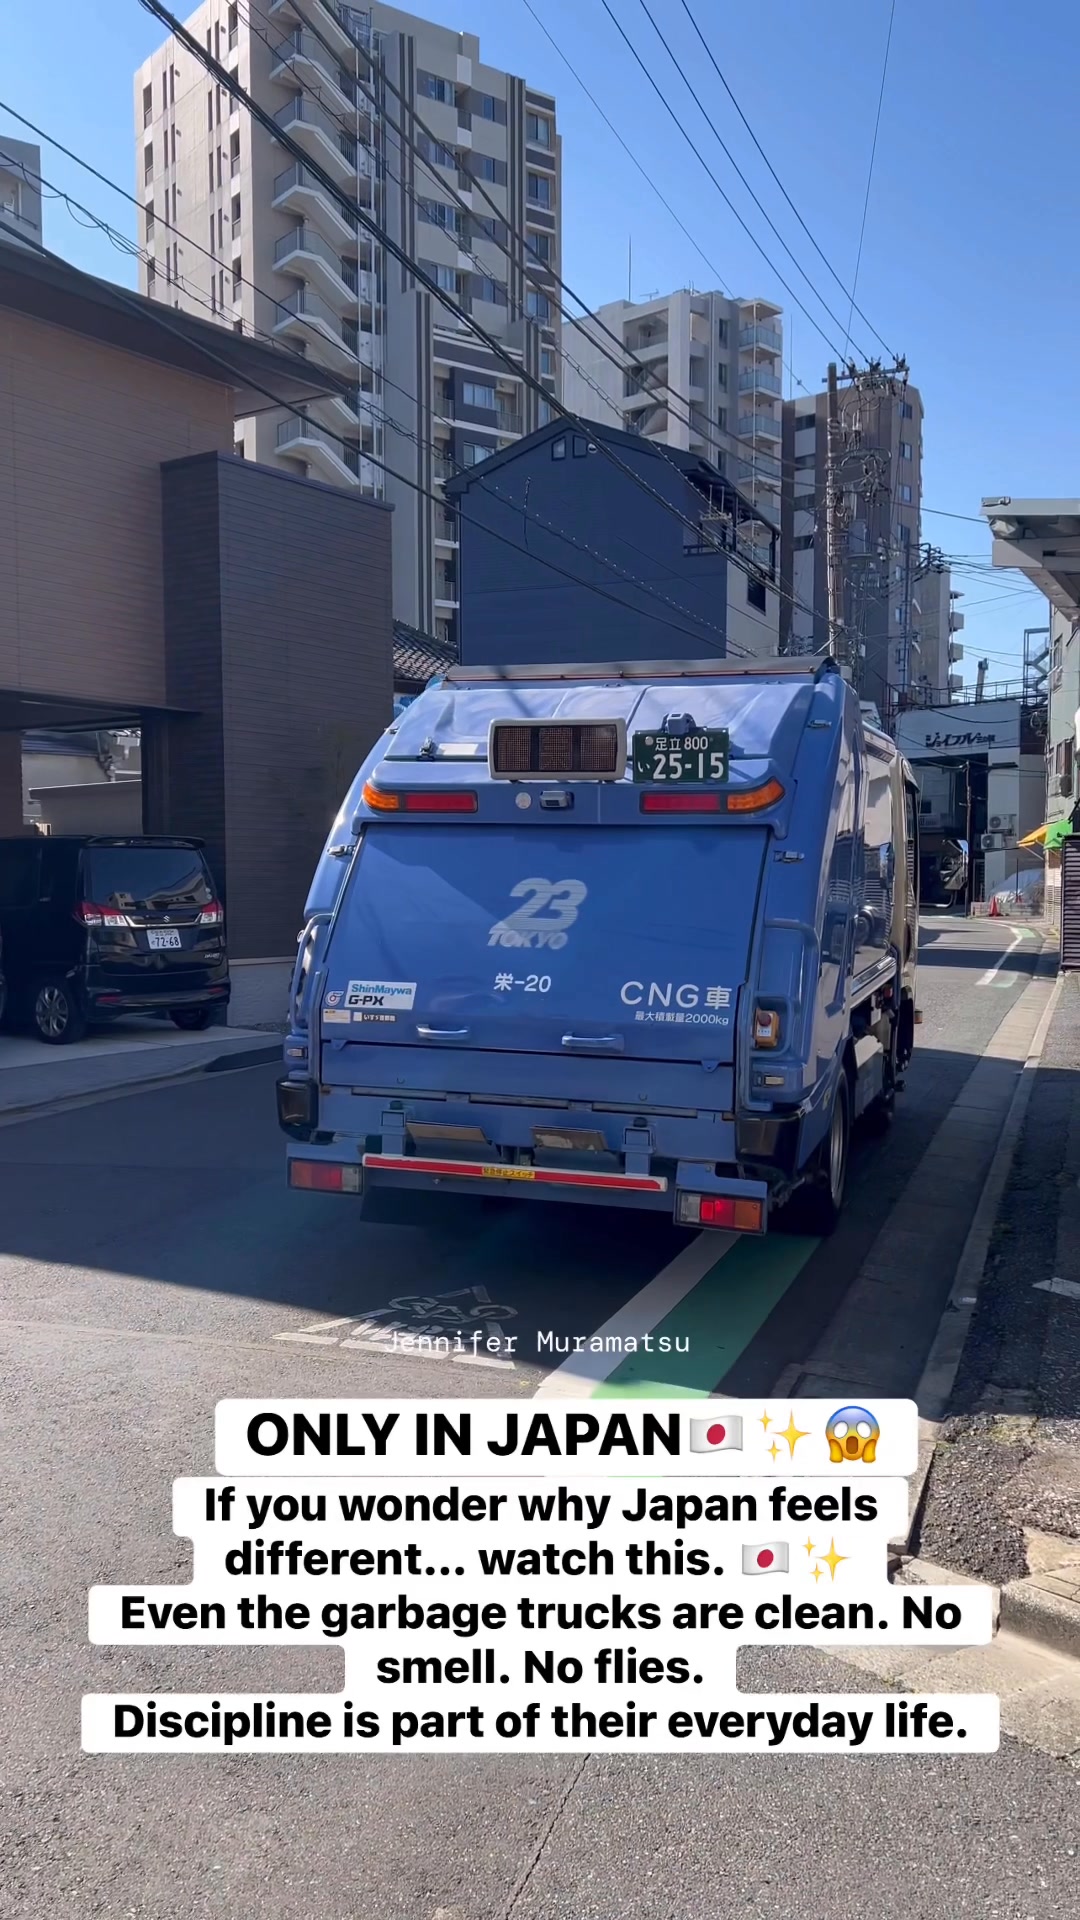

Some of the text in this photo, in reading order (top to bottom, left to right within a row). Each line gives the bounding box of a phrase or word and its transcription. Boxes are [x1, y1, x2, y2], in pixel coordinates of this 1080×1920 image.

[655, 736, 709, 751] 足立 800
[638, 752, 724, 779] い 25-15
[489, 877, 588, 932] 23
[487, 930, 568, 950] TOKYO
[351, 984, 412, 996] ShinMaywa
[348, 994, 385, 1006] G-PX
